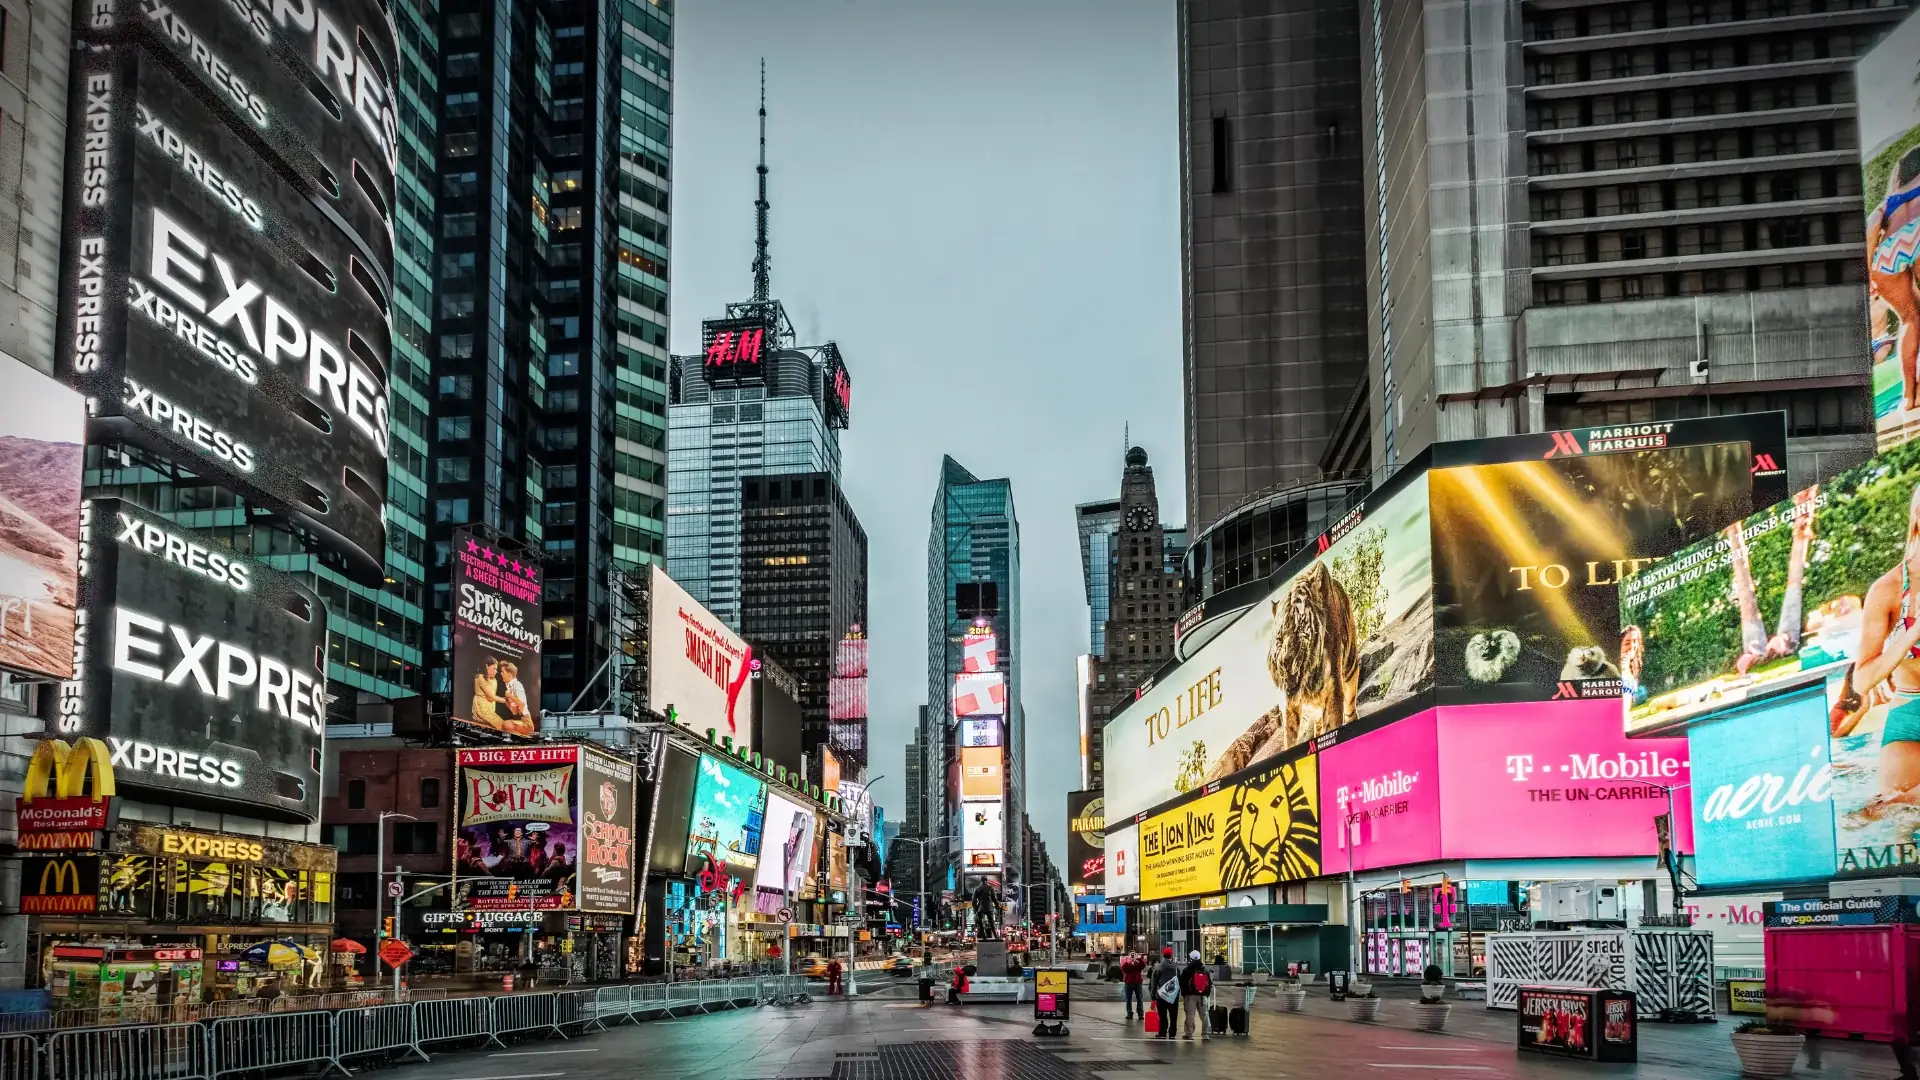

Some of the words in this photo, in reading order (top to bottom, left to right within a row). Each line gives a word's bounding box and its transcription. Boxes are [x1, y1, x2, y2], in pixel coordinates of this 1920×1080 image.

[142, 0, 269, 128] XPRESS
[82, 73, 112, 208] EXPRESS
[135, 102, 264, 231] XPRESS
[74, 237, 104, 374] EXPRESS
[128, 277, 259, 385] XPRESS
[706, 327, 764, 366] H&M
[123, 377, 255, 472] XPRESS
[1589, 423, 1673, 440] MARRIOTT
[1590, 436, 1664, 450] MARQUIS
[1755, 469, 1786, 477] MARRIOTT
[1331, 502, 1365, 534] MARRIOTT
[1331, 516, 1361, 544] MARQUIS
[1626, 579, 1641, 595] NO
[1643, 548, 1714, 587] RETOUCHING
[1715, 538, 1733, 552] ON
[1736, 518, 1778, 540] THESE
[1781, 494, 1827, 523] GIRLS!
[466, 565, 472, 578] A
[473, 567, 498, 589] SHEER
[505, 571, 541, 595] EXHILARATING
[1509, 564, 1570, 591] TO
[1626, 592, 1648, 608] THE
[1650, 579, 1678, 598] REAL
[1680, 567, 1702, 585] YOU
[1705, 561, 1717, 573] IS
[460, 583, 524, 626] SPRING
[457, 605, 542, 653] awakening
[964, 633, 996, 641] TOSHIBA
[968, 626, 991, 636] 2016
[685, 627, 713, 680] SMASH
[715, 649, 731, 695] HIT
[750, 671, 761, 679] LG
[1144, 706, 1170, 748] TO
[1176, 666, 1223, 729] LIFE
[480, 751, 506, 762] BIG,
[510, 750, 537, 761] FAT
[709, 727, 762, 770] 1540
[585, 752, 603, 765] ANDREW
[603, 759, 616, 770] LLOYD
[615, 763, 632, 774] WEBBER
[585, 760, 594, 770] HAS
[594, 764, 614, 776] BROADWAY
[480, 772, 557, 782] SOMETHING
[1528, 789, 1562, 802] THE
[1566, 785, 1671, 802] UN-CARRIER
[1360, 801, 1409, 821] UN-CARRIER
[33, 819, 88, 828] Restaurant
[1072, 817, 1105, 832] PARADI
[1143, 831, 1159, 853] THE
[1161, 822, 1184, 855] LION
[1186, 811, 1215, 848] KING
[163, 833, 264, 862] EXPRESS
[587, 838, 629, 868] ROCK
[1185, 852, 1195, 861] BEST
[1195, 848, 1215, 860] MUSICAL
[1781, 902, 1802, 912] The
[1804, 900, 1843, 911] Official
[1846, 898, 1882, 909] Guide
[423, 912, 464, 923] GIFTS
[475, 912, 543, 922] LUGGAGE
[1781, 913, 1840, 925] nycgo.com
[1587, 936, 1624, 954] snack
[1610, 955, 1626, 984] BOX
[1523, 998, 1561, 1017] JERSEY
[1561, 1000, 1587, 1021] BOYS
[1605, 1001, 1628, 1015] JERSEY
[1608, 1013, 1625, 1023] BOYS
